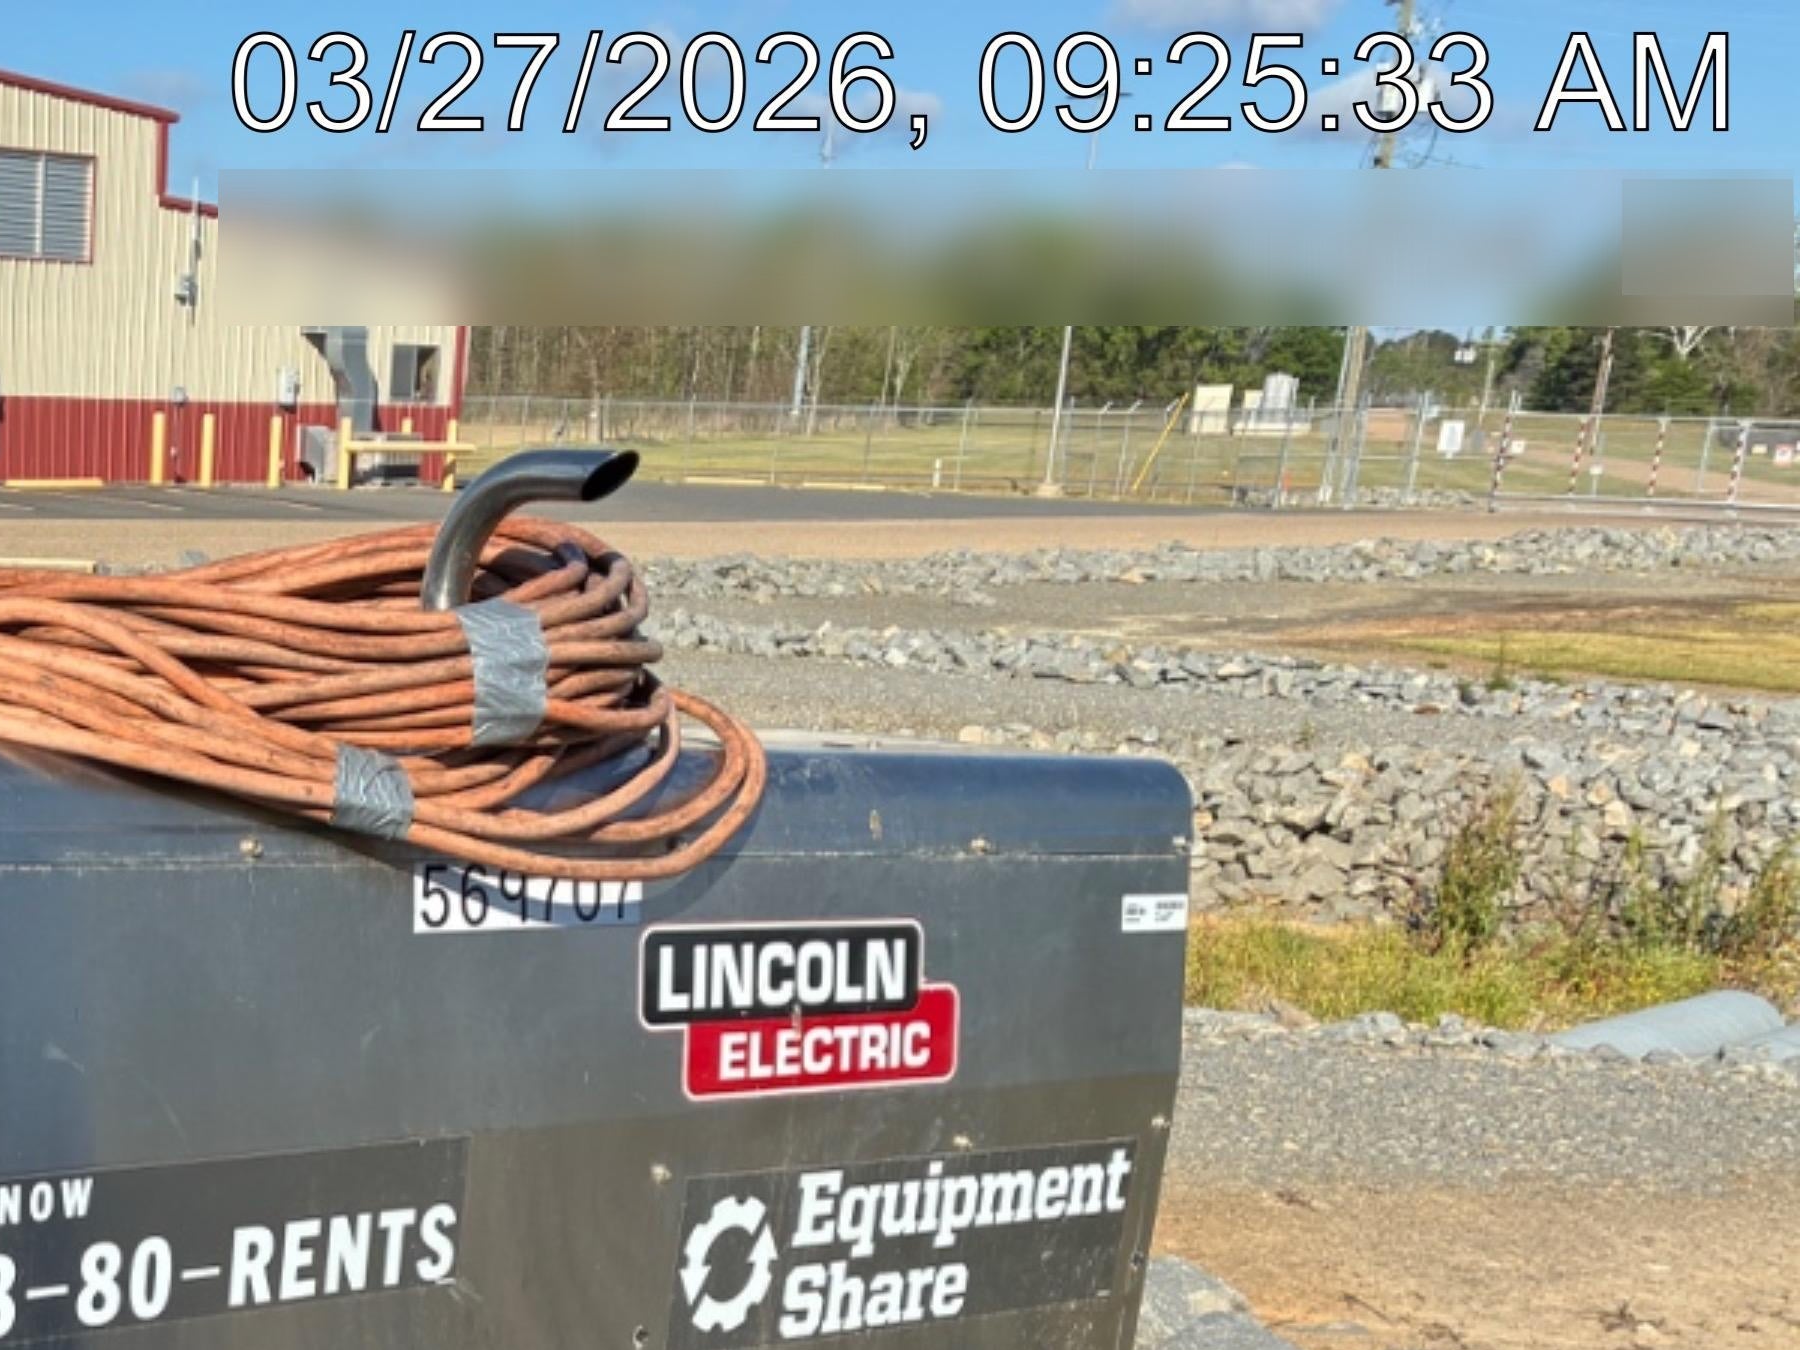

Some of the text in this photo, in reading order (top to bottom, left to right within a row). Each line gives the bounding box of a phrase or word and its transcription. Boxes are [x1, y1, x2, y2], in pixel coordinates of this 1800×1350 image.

[658, 937, 909, 1013] LINCOLN
[718, 1020, 933, 1082] ELECTRIC
[790, 1149, 1133, 1257] Equipment
[779, 1262, 968, 1340] Share
